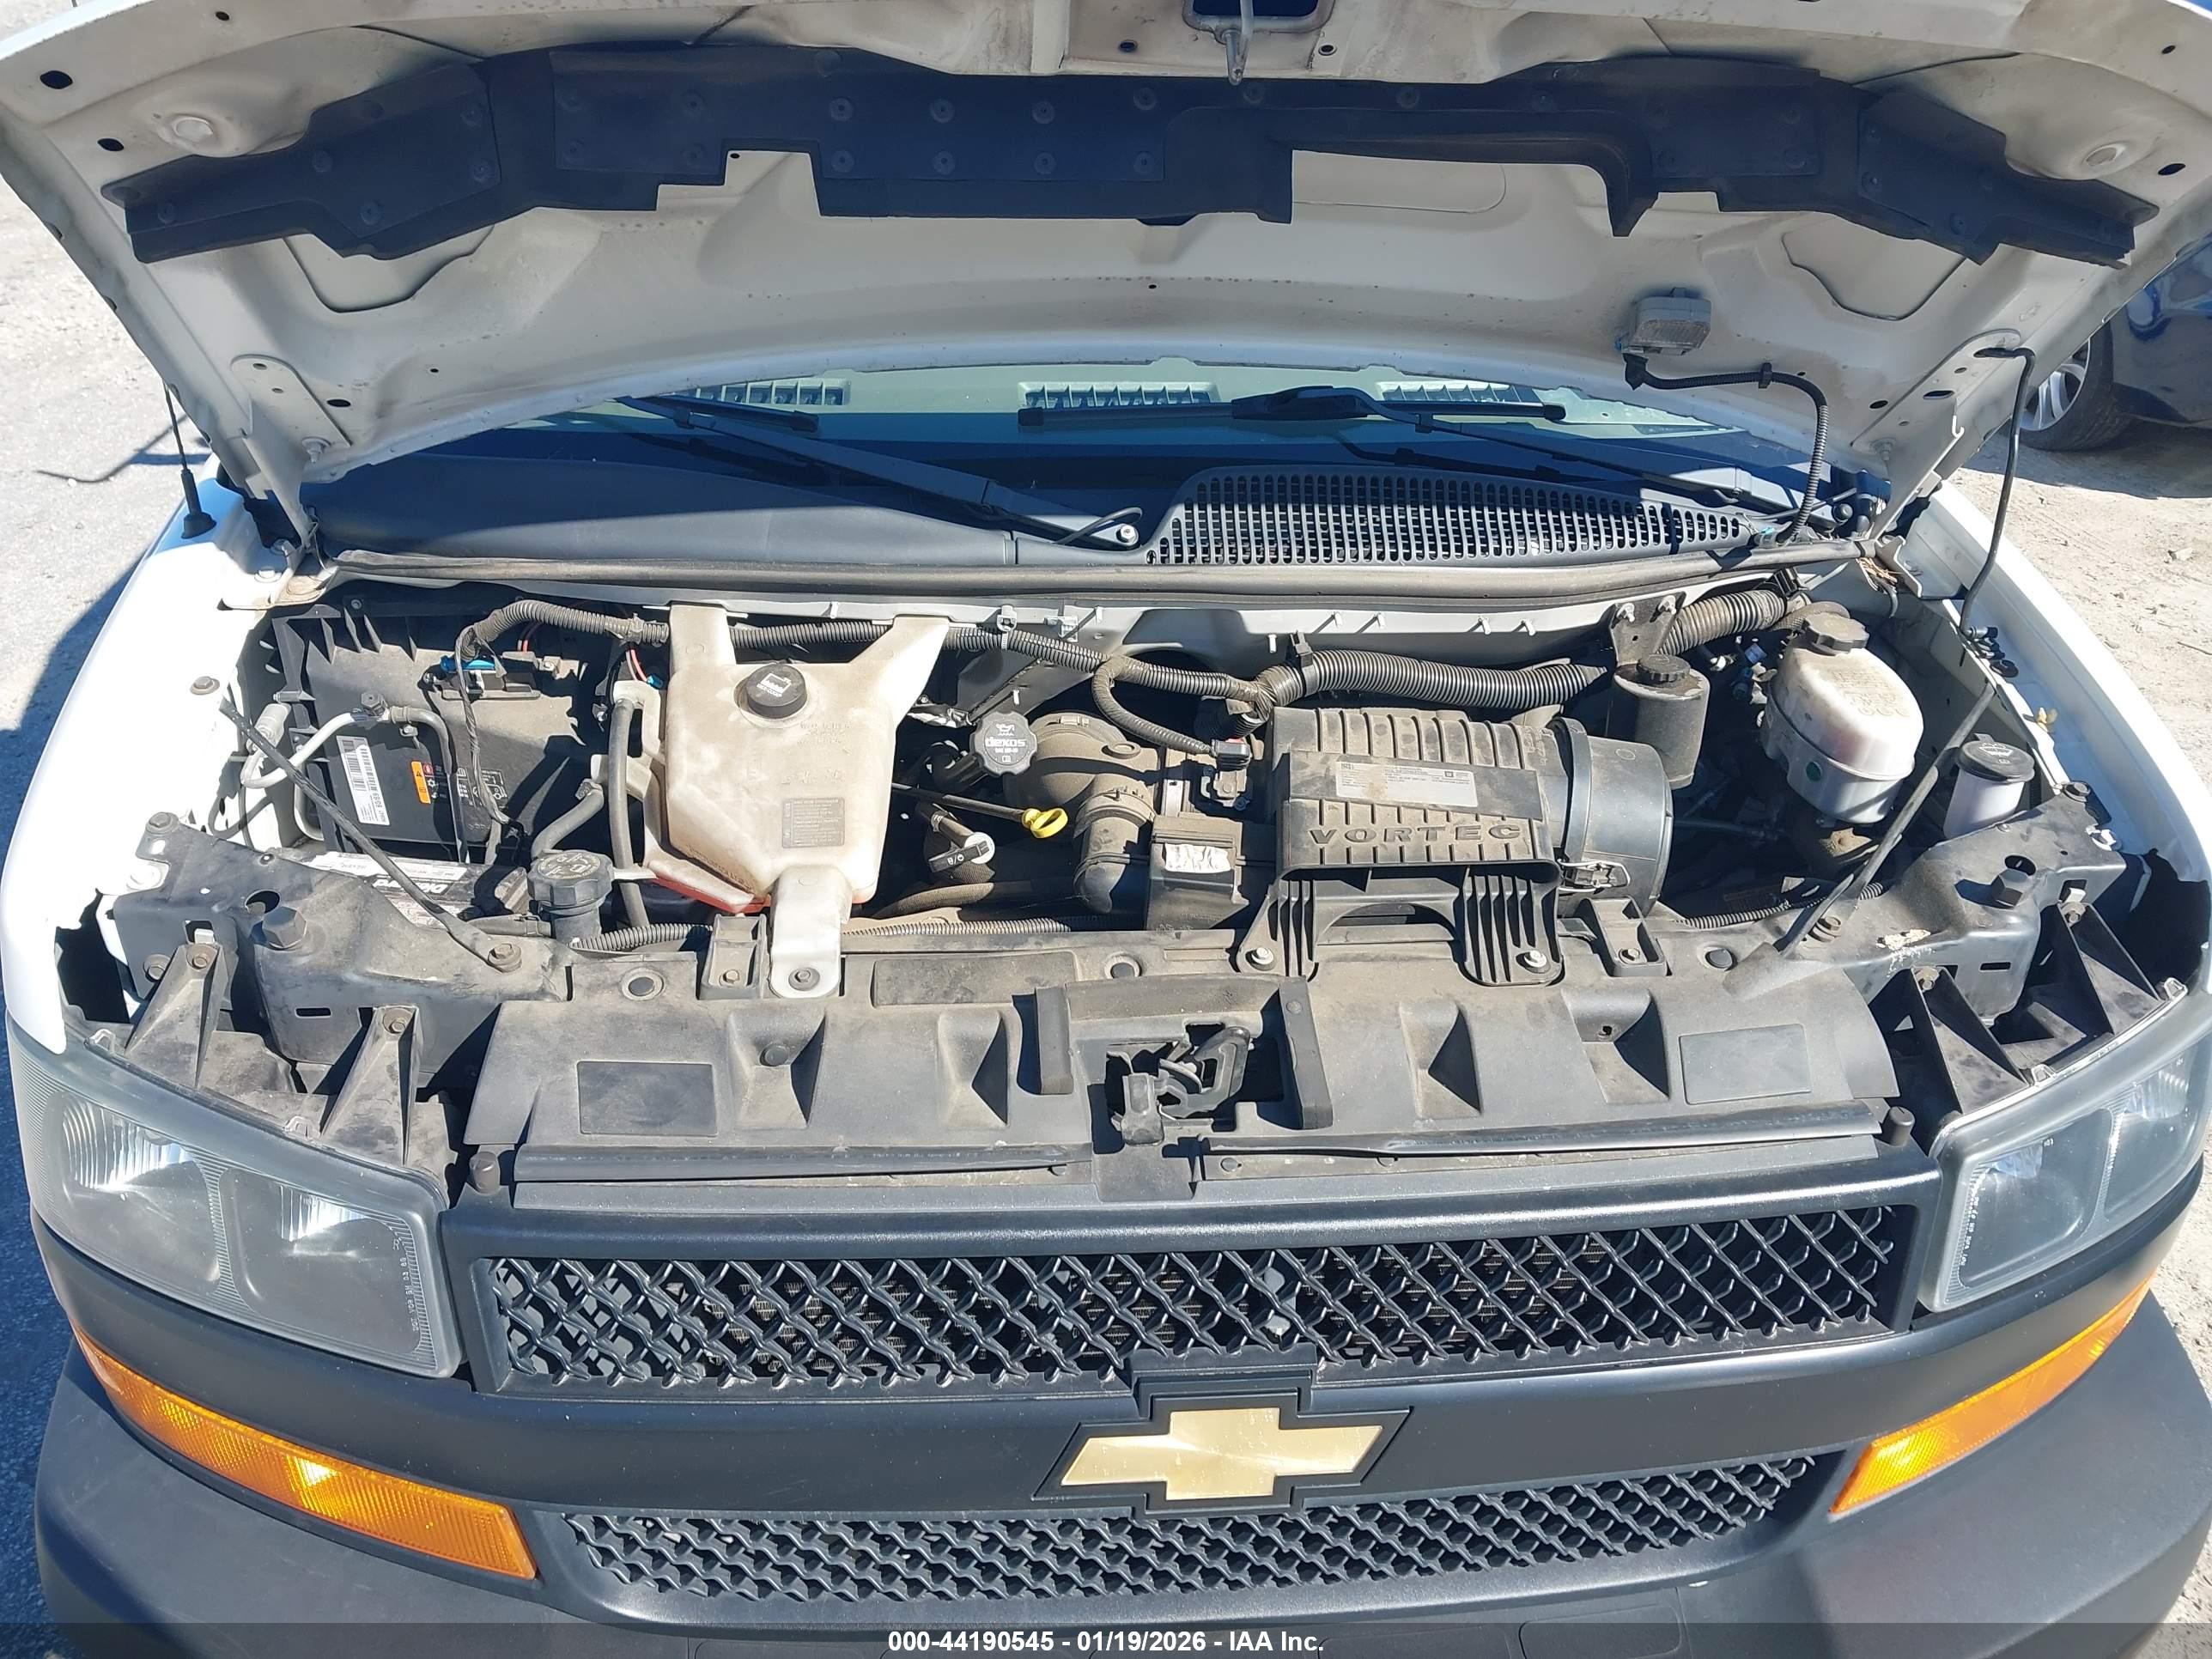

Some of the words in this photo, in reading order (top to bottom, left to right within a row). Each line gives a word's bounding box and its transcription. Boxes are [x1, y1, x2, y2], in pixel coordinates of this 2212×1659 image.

[985, 736, 1027, 747] dexos
[1309, 824, 1521, 844] VORTEC
[410, 1317, 419, 1331] DOT
